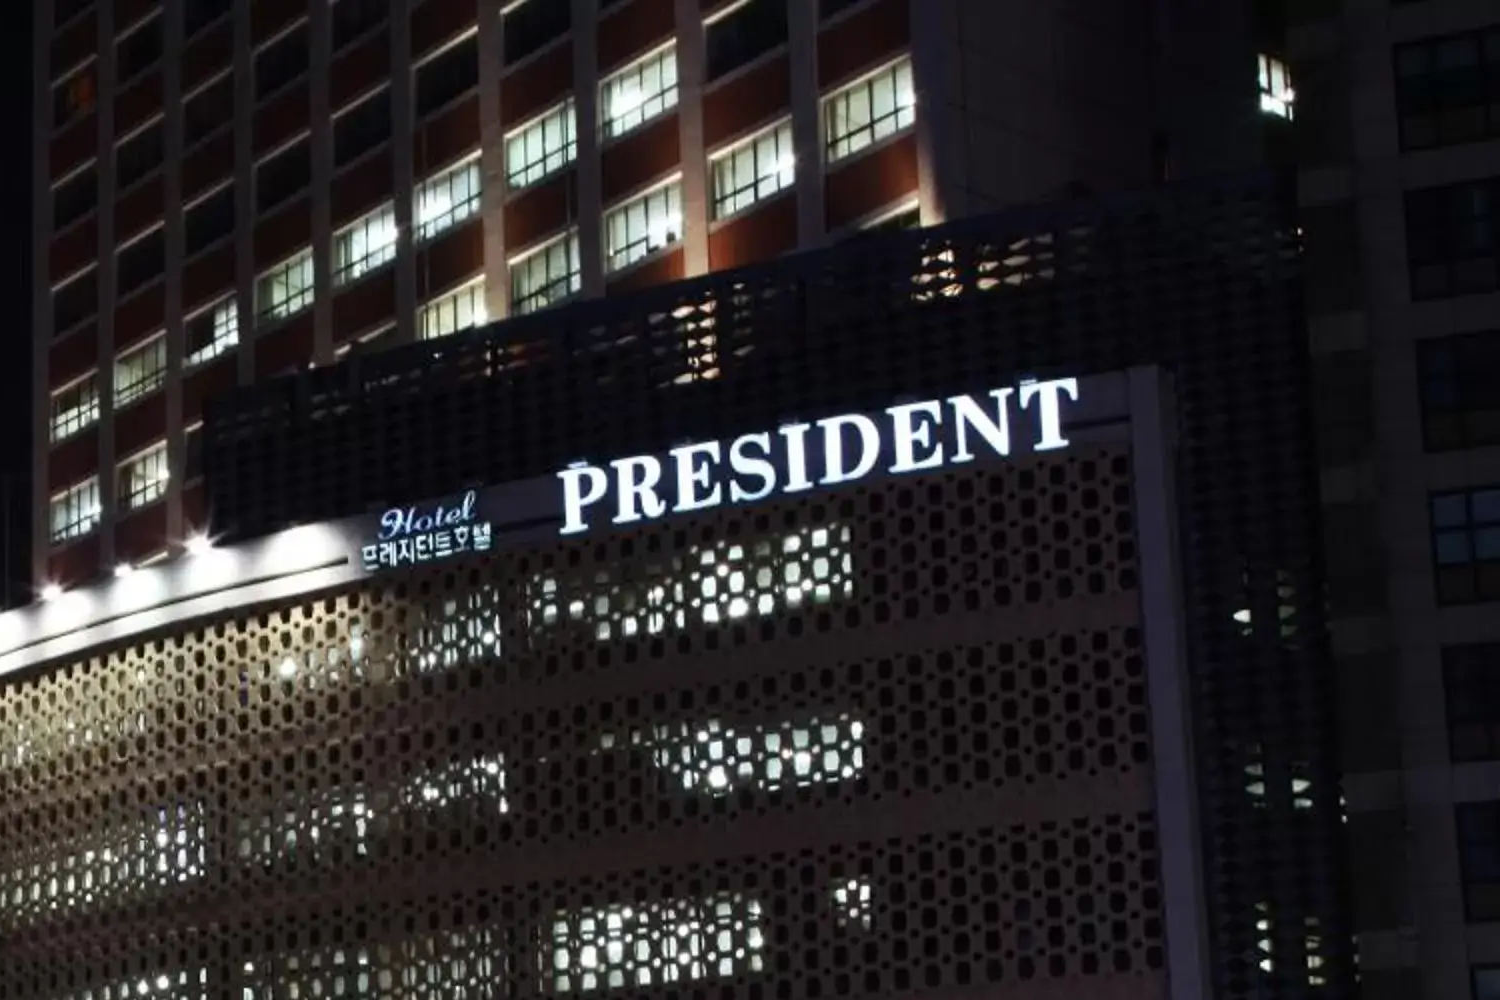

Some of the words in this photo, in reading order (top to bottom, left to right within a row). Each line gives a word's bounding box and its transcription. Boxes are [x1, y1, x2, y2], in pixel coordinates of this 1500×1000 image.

[557, 376, 1079, 536] PRESIDENT
[378, 490, 476, 539] Hotel
[362, 522, 493, 570] 프레지던트호텔
